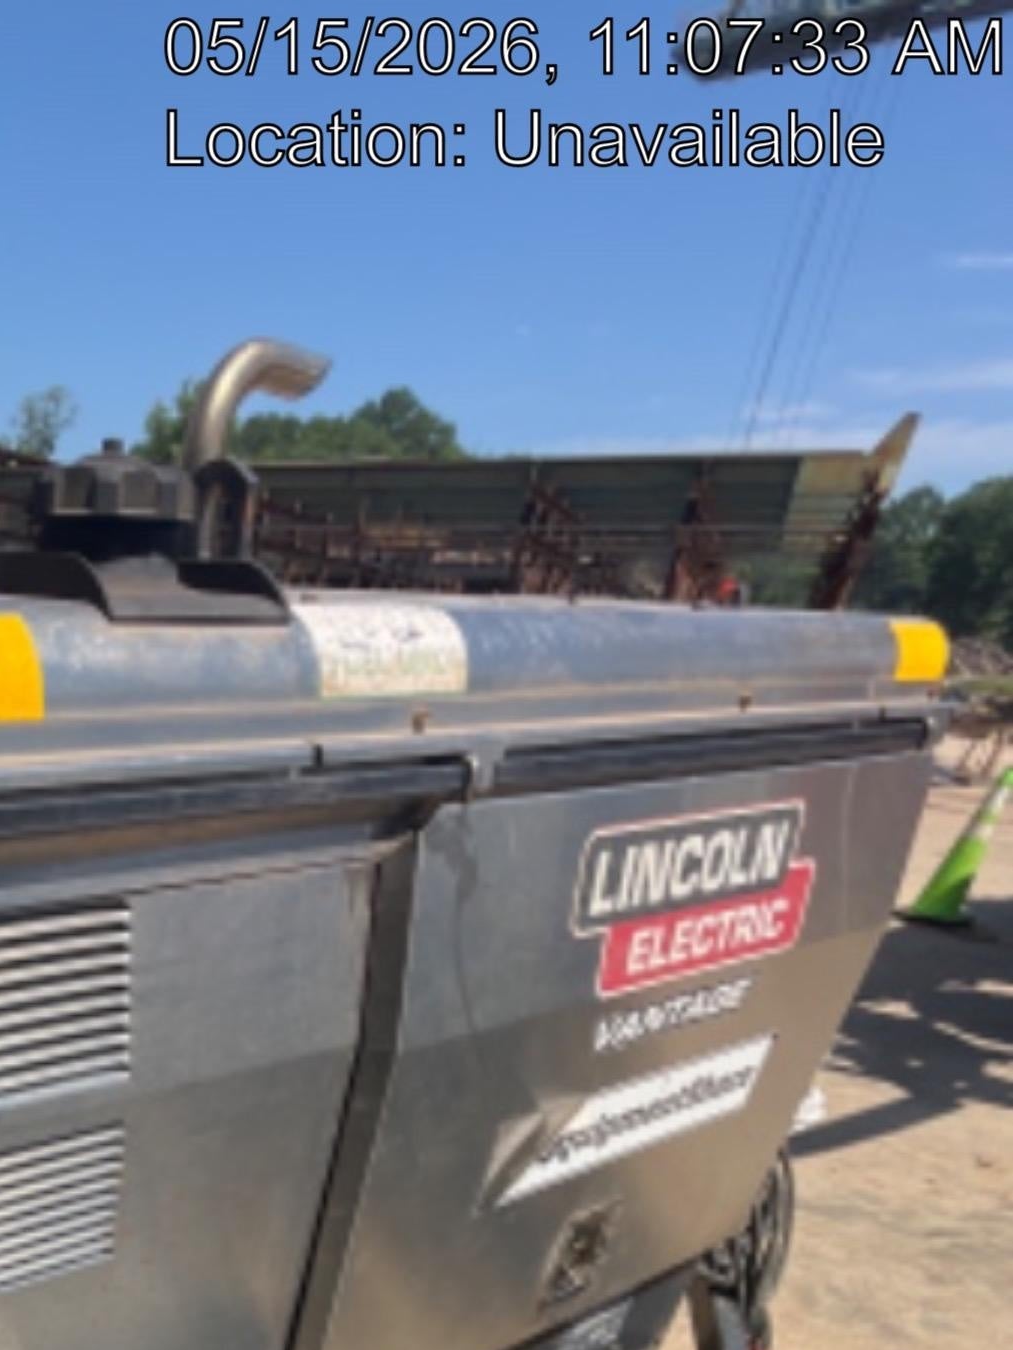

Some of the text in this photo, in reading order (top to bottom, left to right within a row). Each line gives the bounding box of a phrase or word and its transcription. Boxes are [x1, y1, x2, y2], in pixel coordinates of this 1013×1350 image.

[589, 819, 791, 917] LINCOLN
[627, 900, 790, 974] ELECTRIC
[594, 979, 752, 1051] VANTAGE
